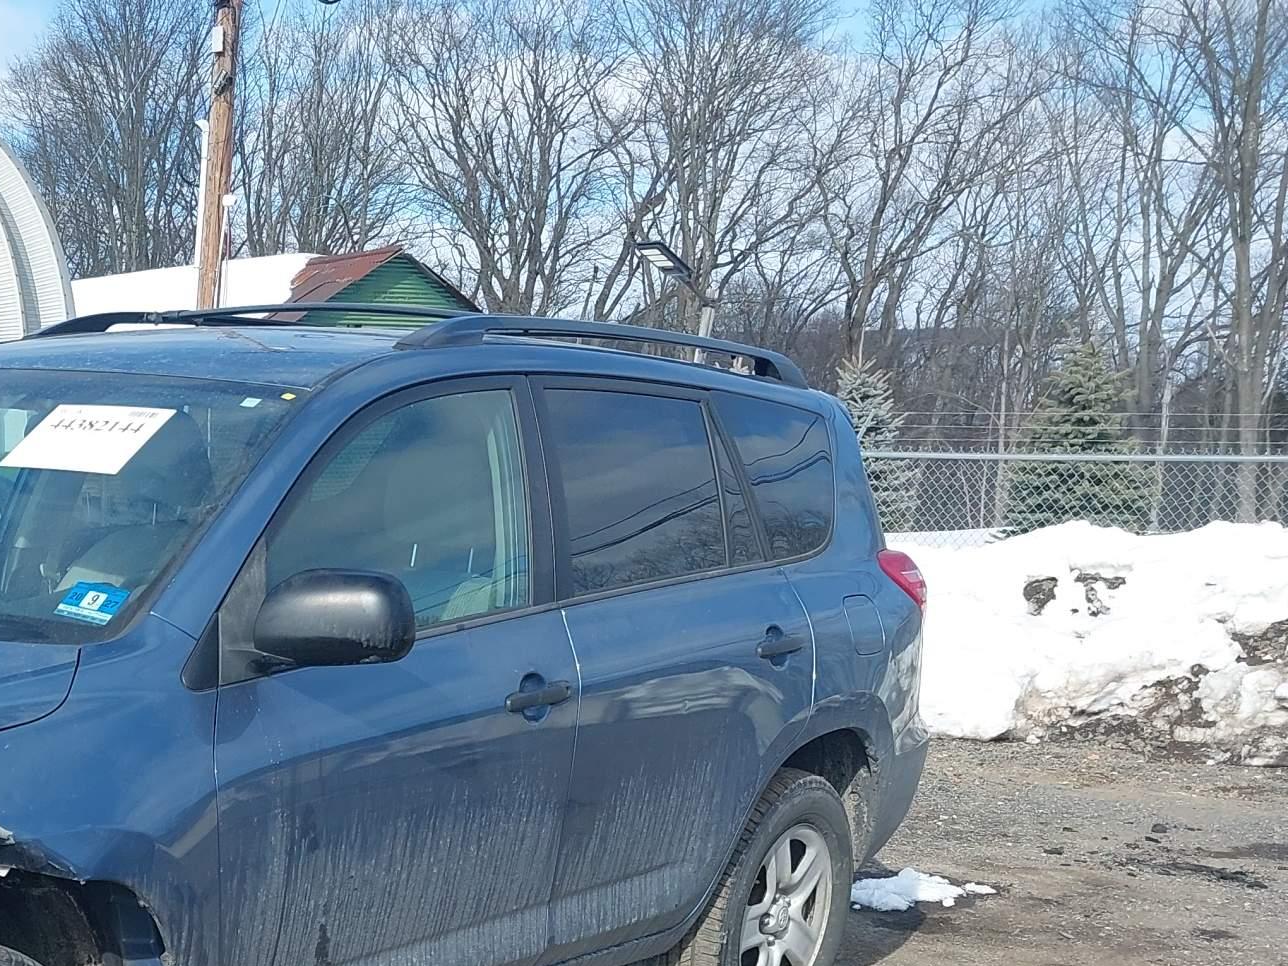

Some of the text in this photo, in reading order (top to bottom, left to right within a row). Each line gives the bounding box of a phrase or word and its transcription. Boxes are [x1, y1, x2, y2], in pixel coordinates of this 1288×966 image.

[50, 418, 146, 434] 44382144
[69, 592, 120, 609] 20 9 27
